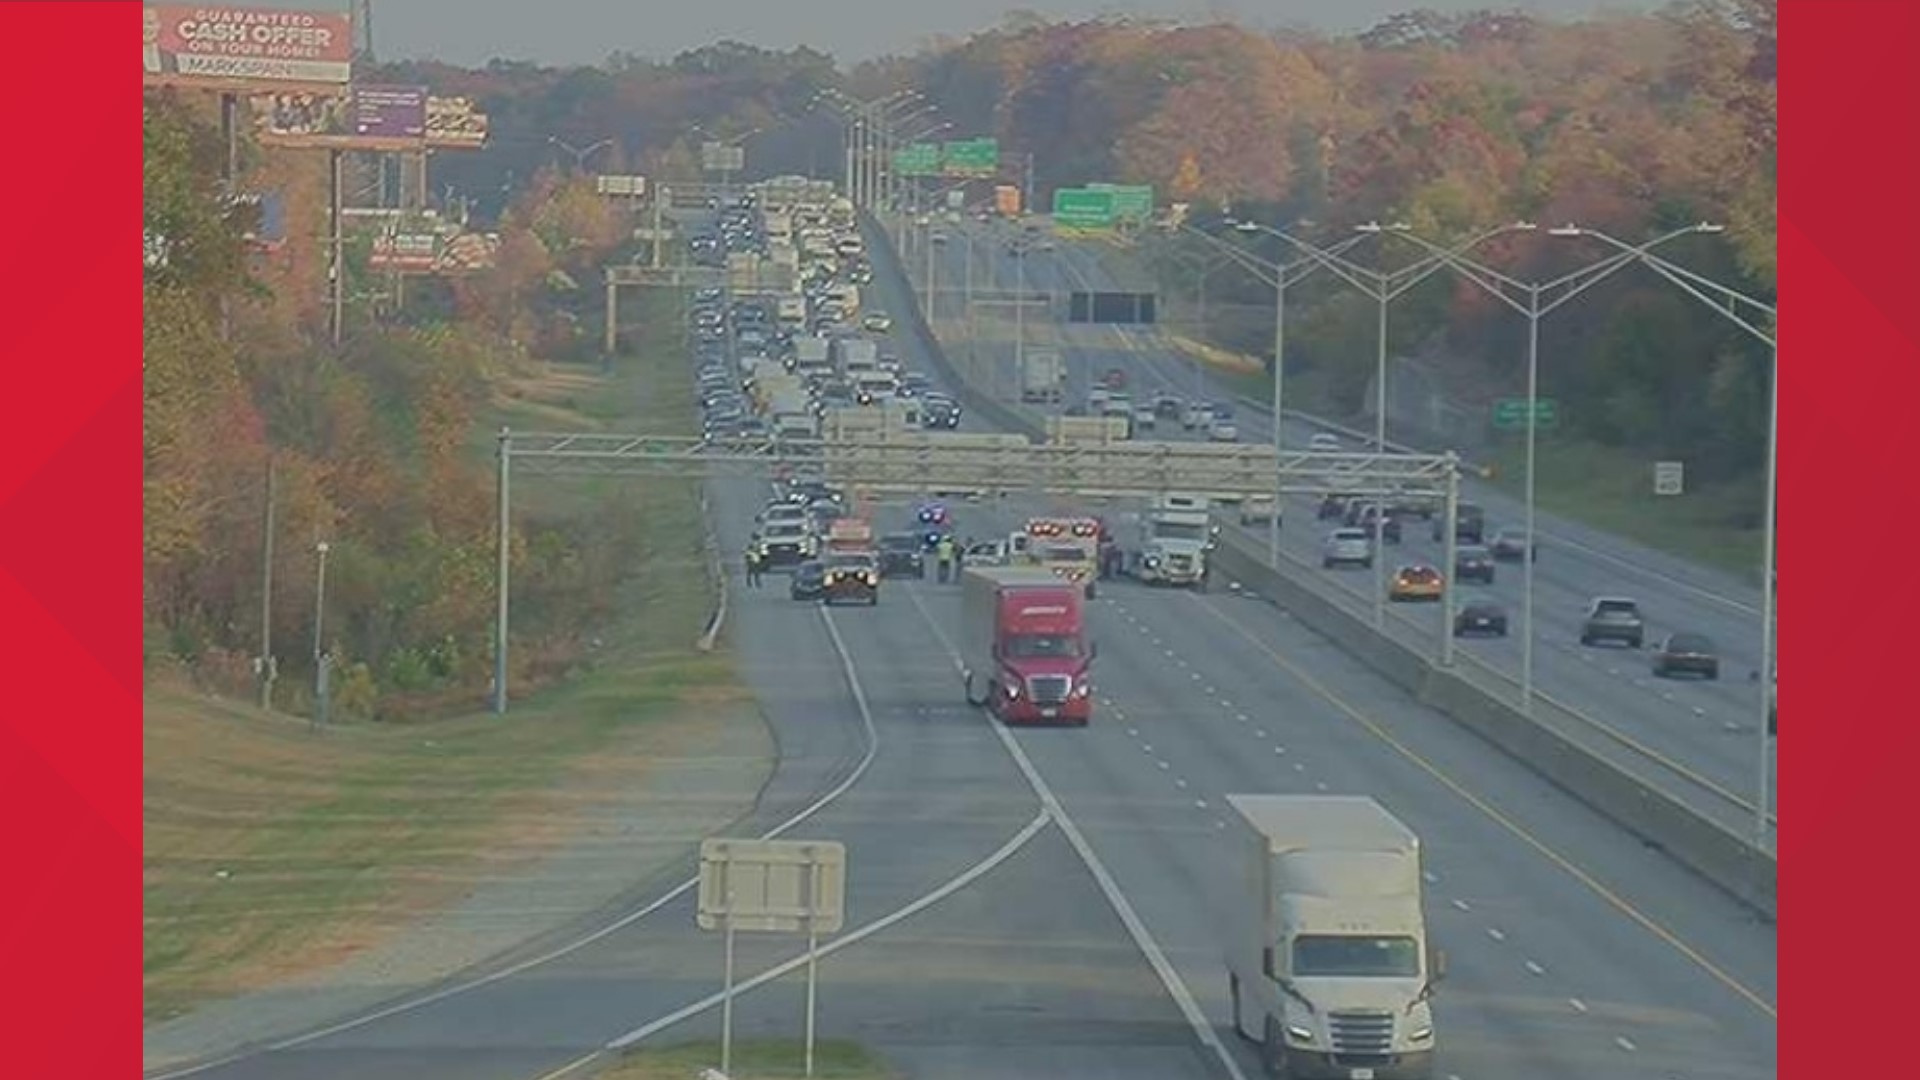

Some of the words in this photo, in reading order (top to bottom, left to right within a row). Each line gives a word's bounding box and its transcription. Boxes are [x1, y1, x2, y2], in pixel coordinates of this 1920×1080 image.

[196, 10, 315, 27] GUARANTEED
[178, 20, 247, 43] CASH
[252, 26, 333, 47] OFFER
[188, 40, 214, 53] ON
[220, 42, 263, 55] YOUR
